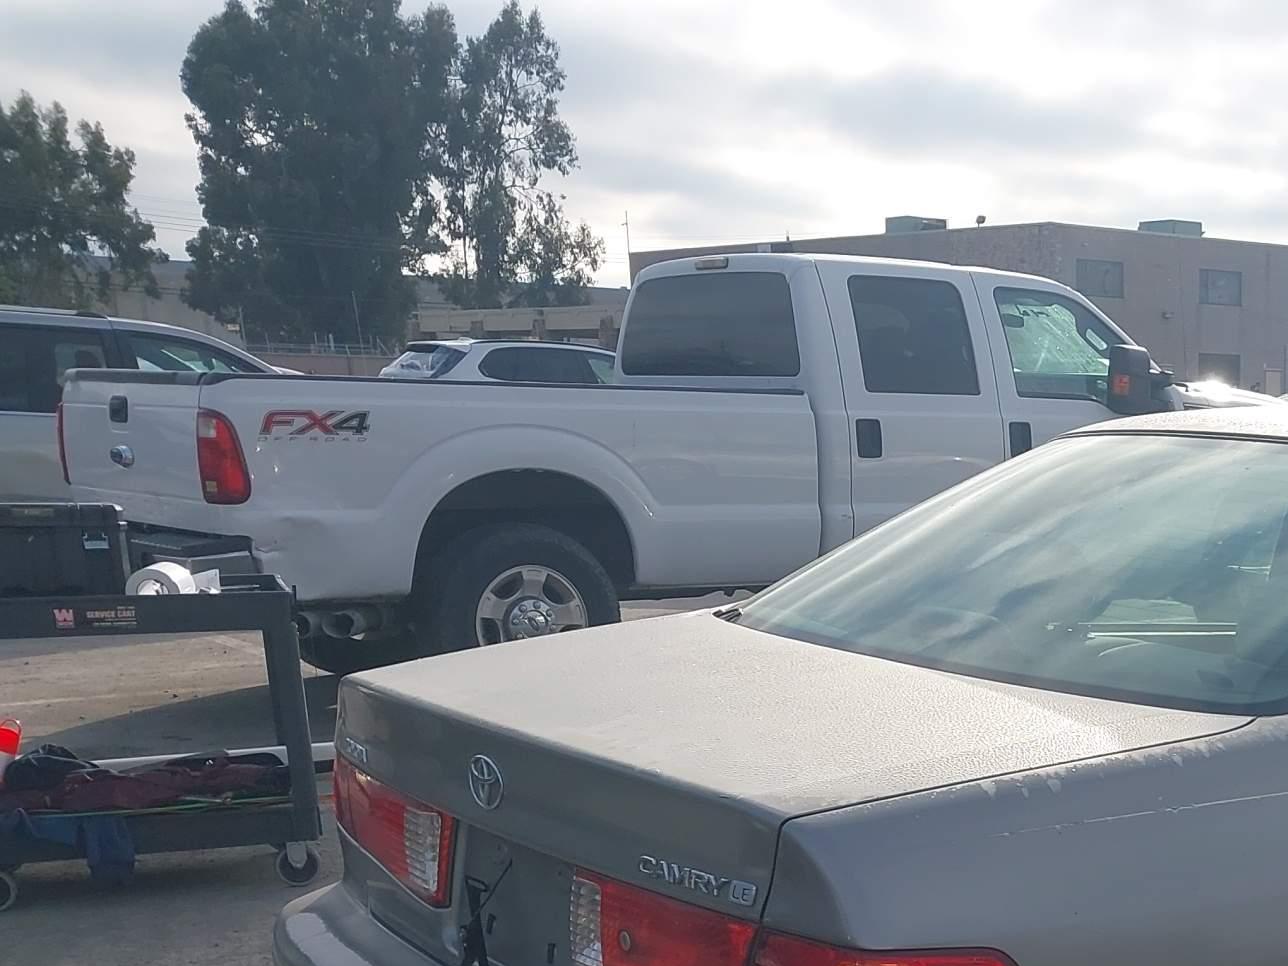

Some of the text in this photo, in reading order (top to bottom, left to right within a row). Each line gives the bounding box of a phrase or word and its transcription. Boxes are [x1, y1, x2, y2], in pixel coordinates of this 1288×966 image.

[259, 409, 370, 435] FX4
[639, 855, 756, 904] CAMRY LE
